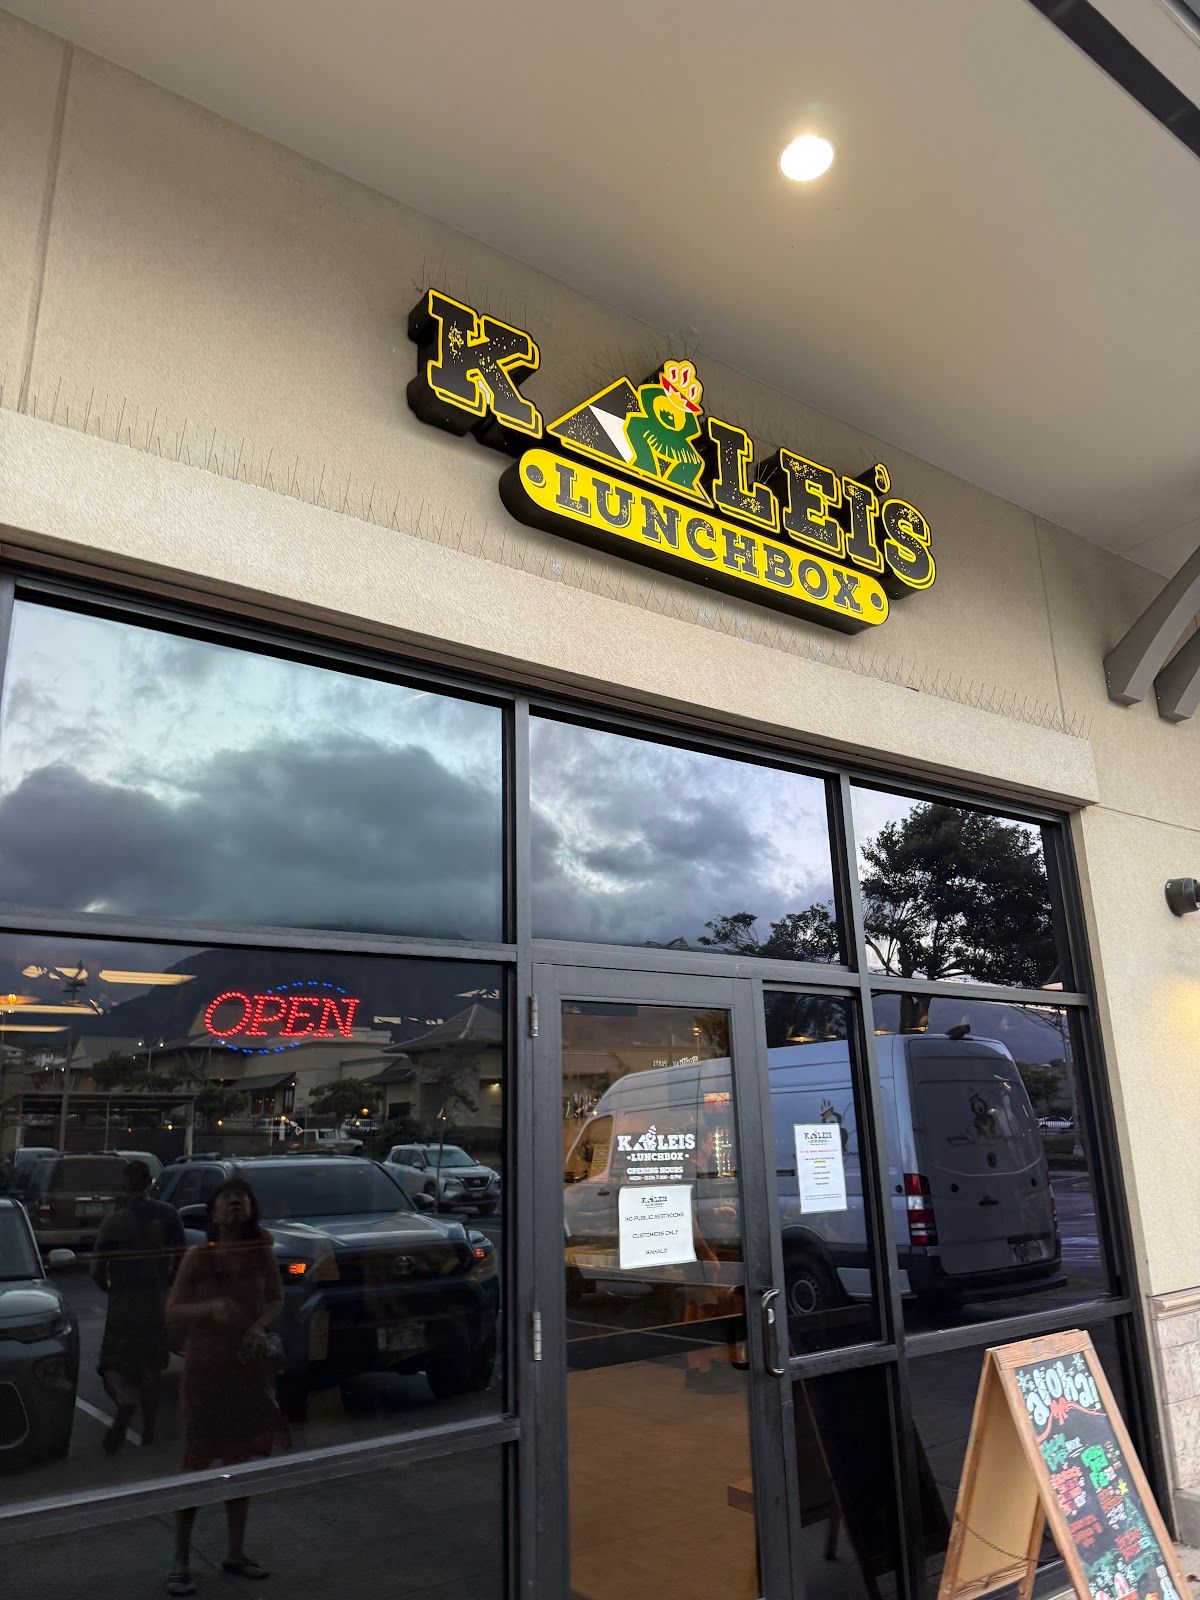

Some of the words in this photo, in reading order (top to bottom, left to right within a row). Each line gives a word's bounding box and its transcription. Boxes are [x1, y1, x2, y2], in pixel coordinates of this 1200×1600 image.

[555, 462, 863, 613] LUNCHBOX
[205, 992, 360, 1038] OPEN
[630, 1152, 684, 1161] LUNCHBOX
